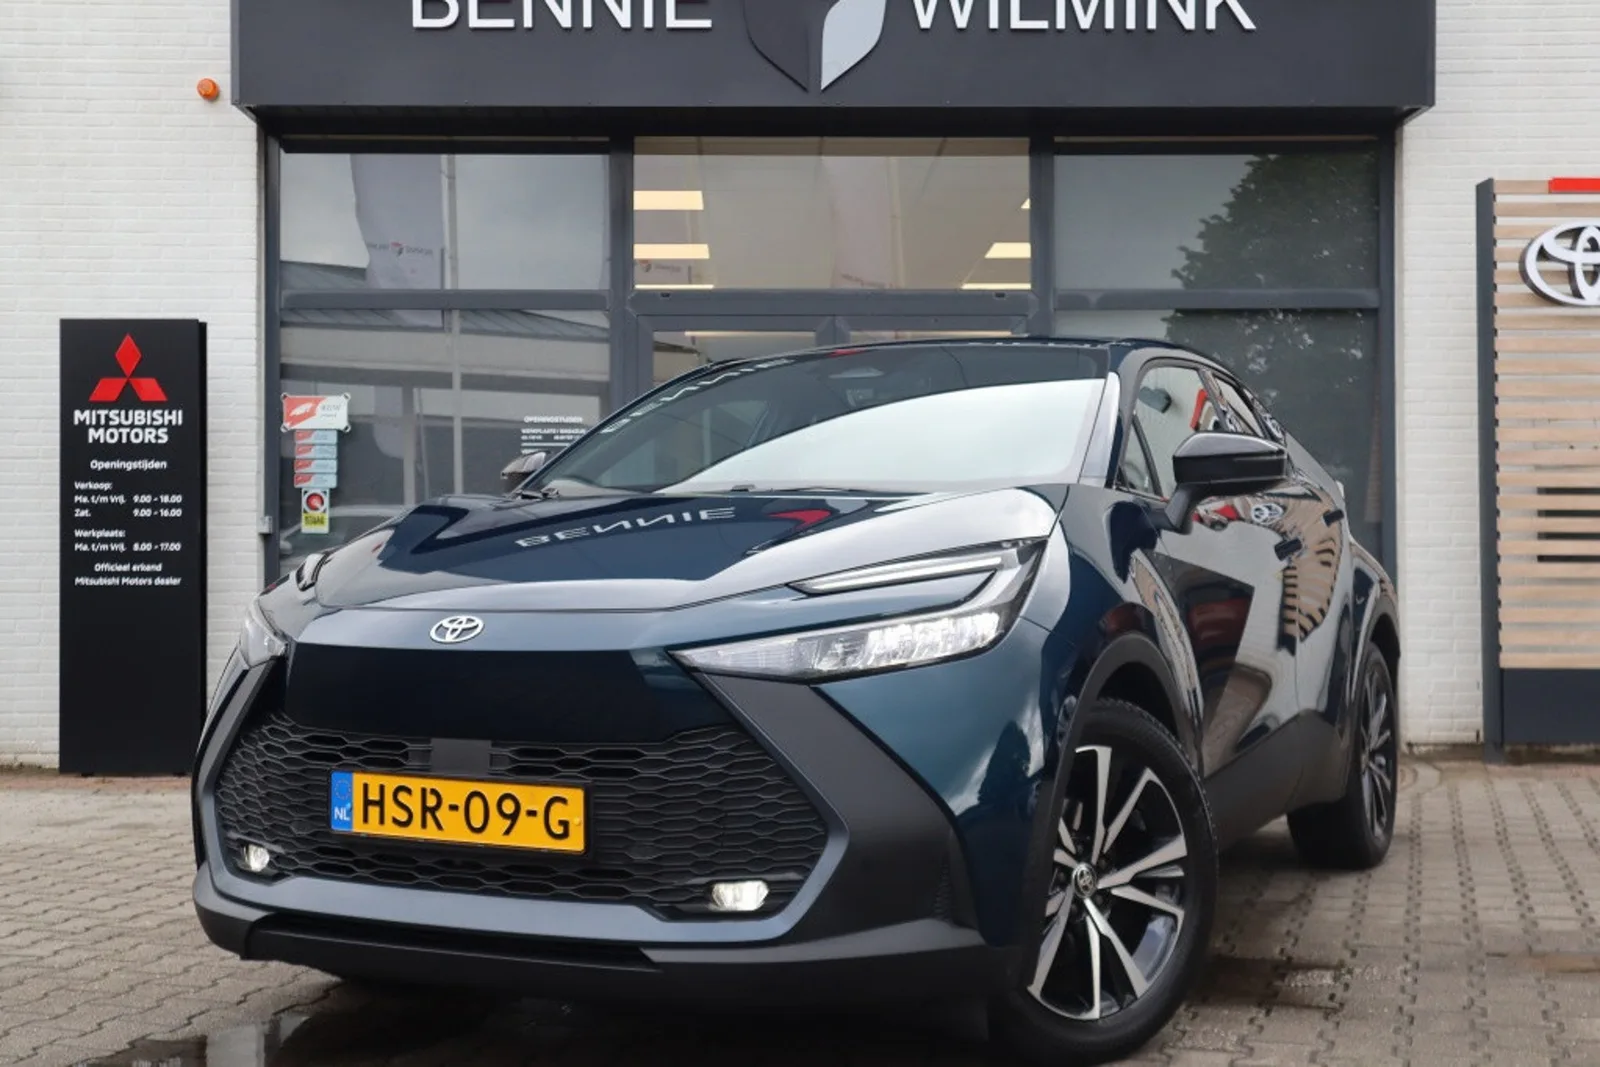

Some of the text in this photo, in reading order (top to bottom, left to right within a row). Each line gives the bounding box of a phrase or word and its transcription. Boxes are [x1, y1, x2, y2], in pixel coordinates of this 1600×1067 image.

[73, 409, 184, 427] MITSUBISHI
[87, 427, 169, 444] MOTORS
[90, 459, 168, 471] Openingstijden
[74, 481, 113, 492] Verkoop:
[91, 495, 109, 505] t/m
[132, 495, 153, 504] 9.00
[159, 495, 183, 504] 18.00
[74, 508, 92, 518] Zat.
[132, 508, 153, 518] 9.00
[74, 529, 126, 540] Werkplaats:
[91, 543, 109, 553] t/m
[159, 542, 182, 552] 17.00
[94, 562, 163, 573] Officieel erkend
[74, 576, 182, 587] Mitsubishi Motors dealer
[334, 808, 351, 822] NL
[362, 782, 571, 841] HSR-09-G
